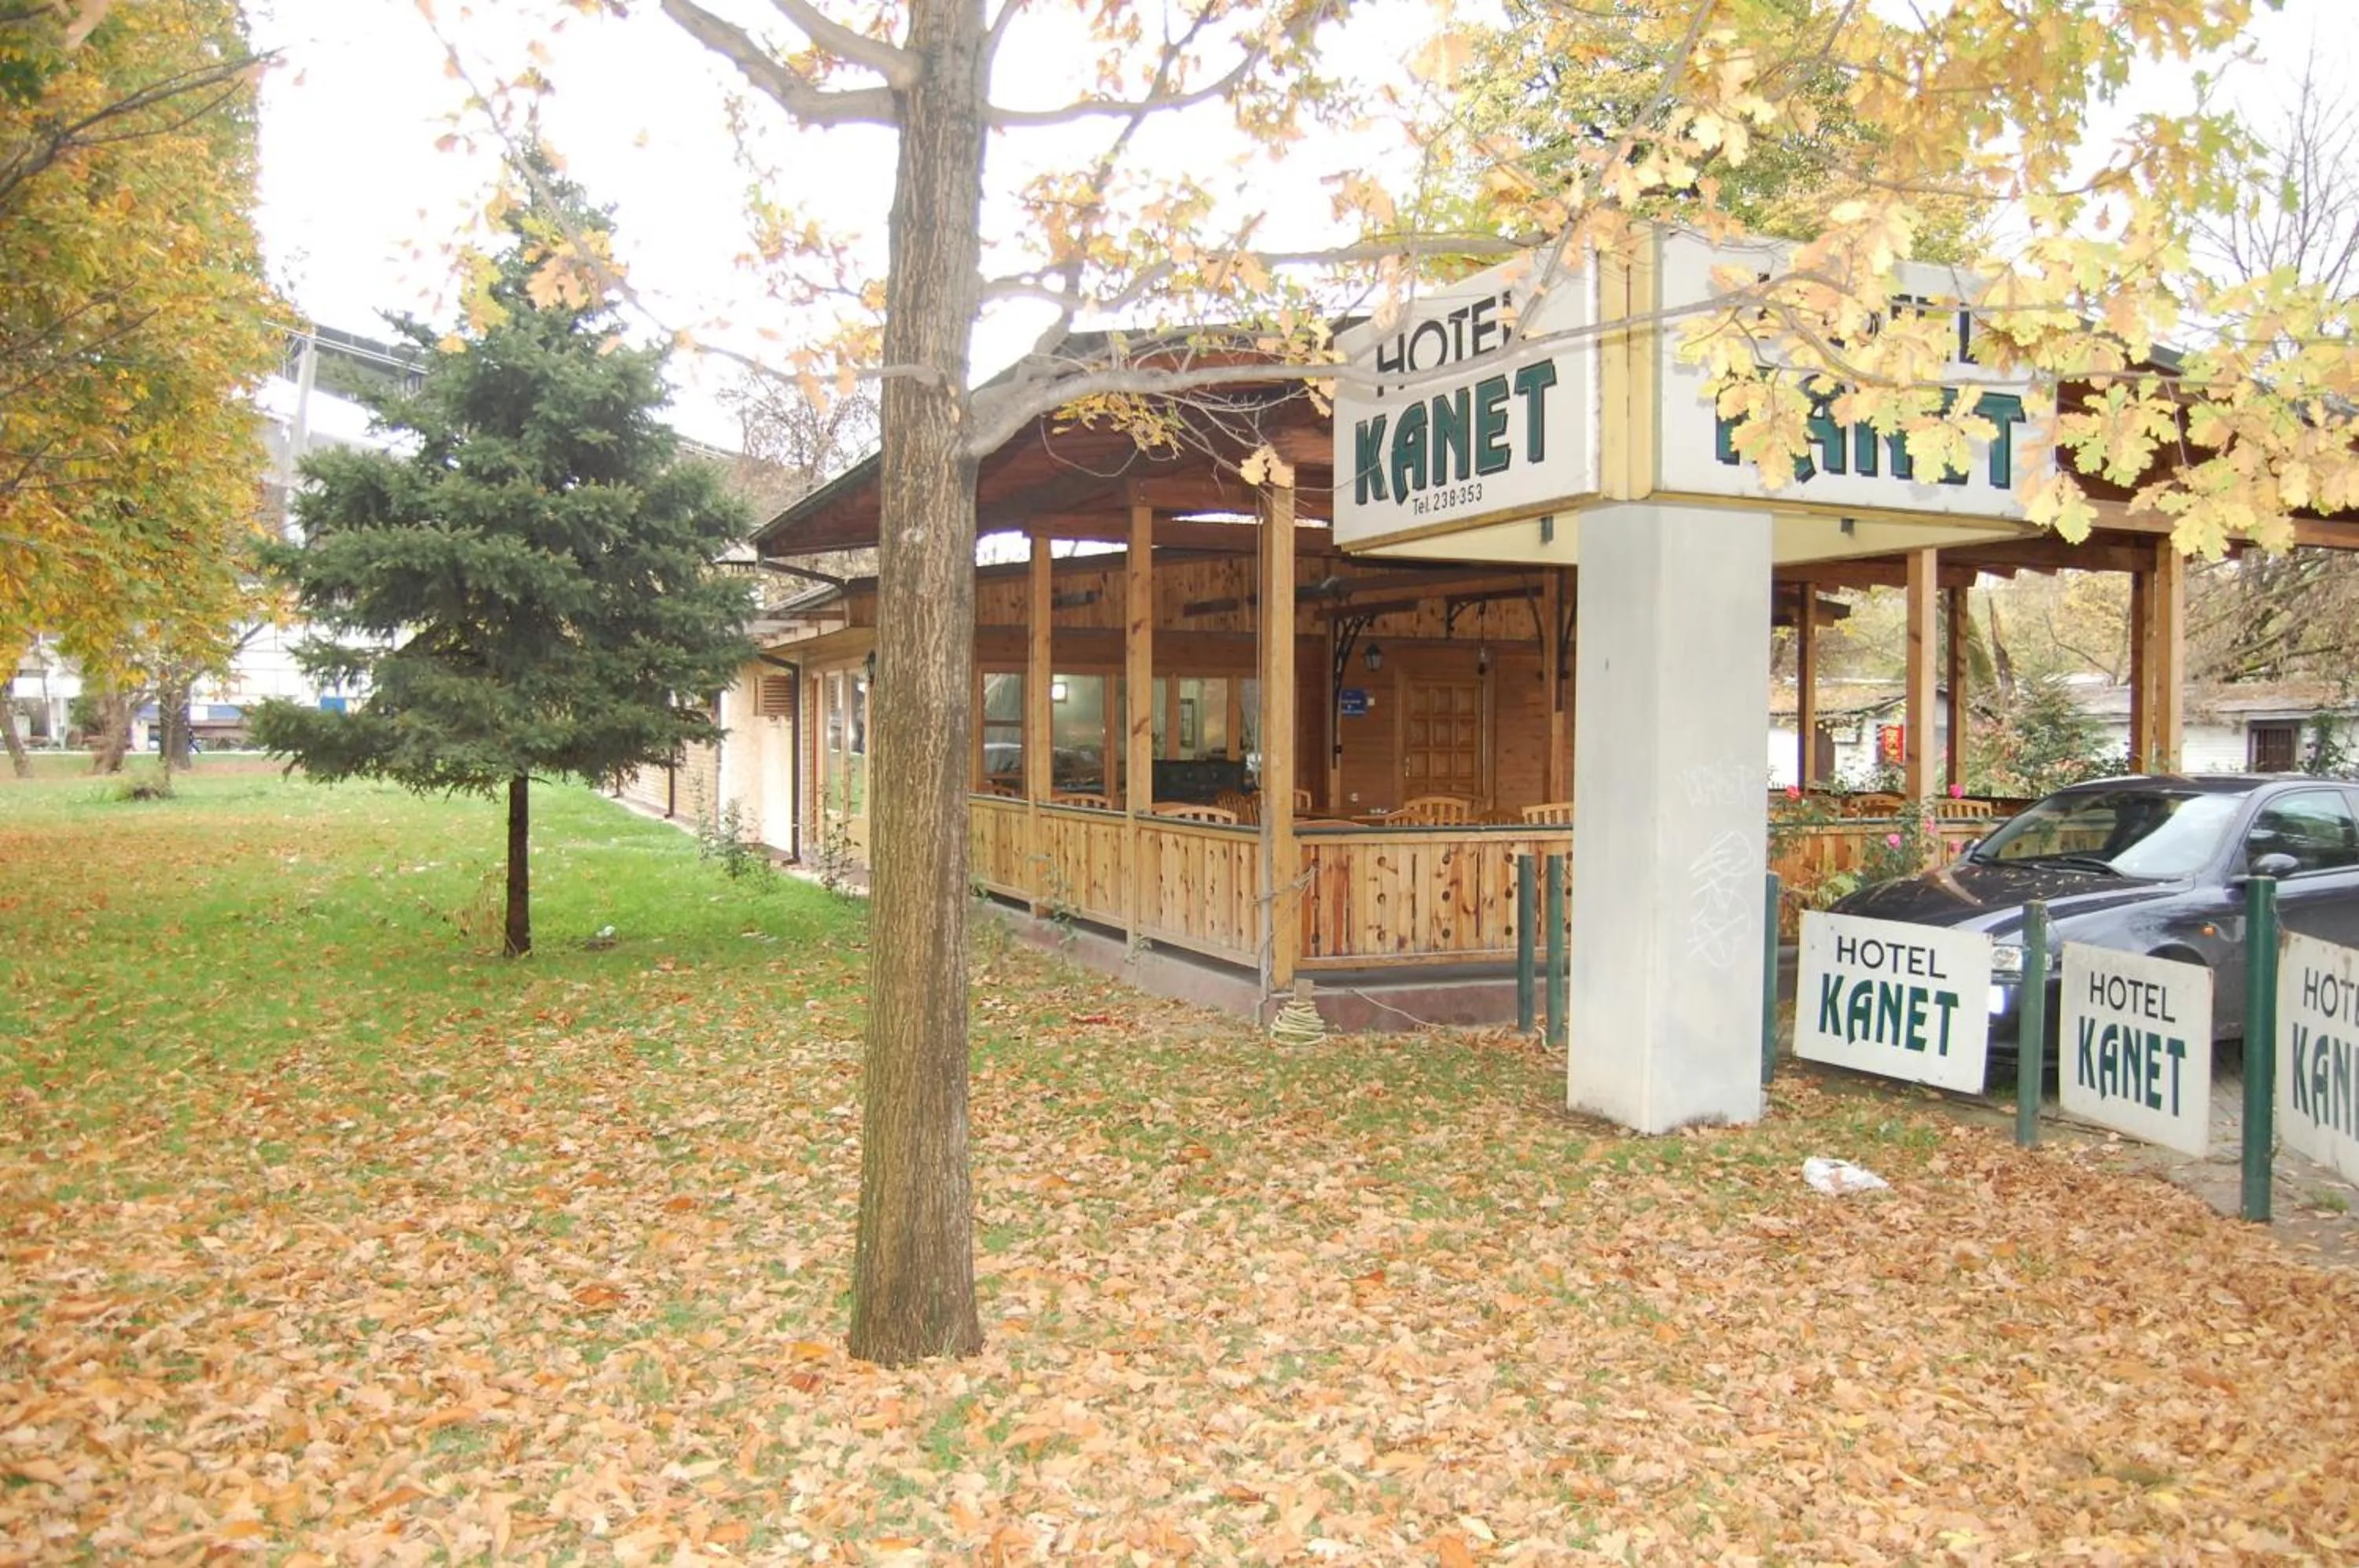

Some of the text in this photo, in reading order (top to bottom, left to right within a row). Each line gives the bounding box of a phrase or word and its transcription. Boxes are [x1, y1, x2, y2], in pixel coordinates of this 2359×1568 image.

[1356, 358, 1557, 505] KANET
[1837, 935, 1947, 978] HOTEL
[2090, 970, 2176, 1023] HOTEL
[2304, 966, 2359, 1028] HOT
[1819, 973, 1959, 1056] KANET
[2078, 1015, 2186, 1117] KANET
[2293, 1022, 2359, 1143] KAN
